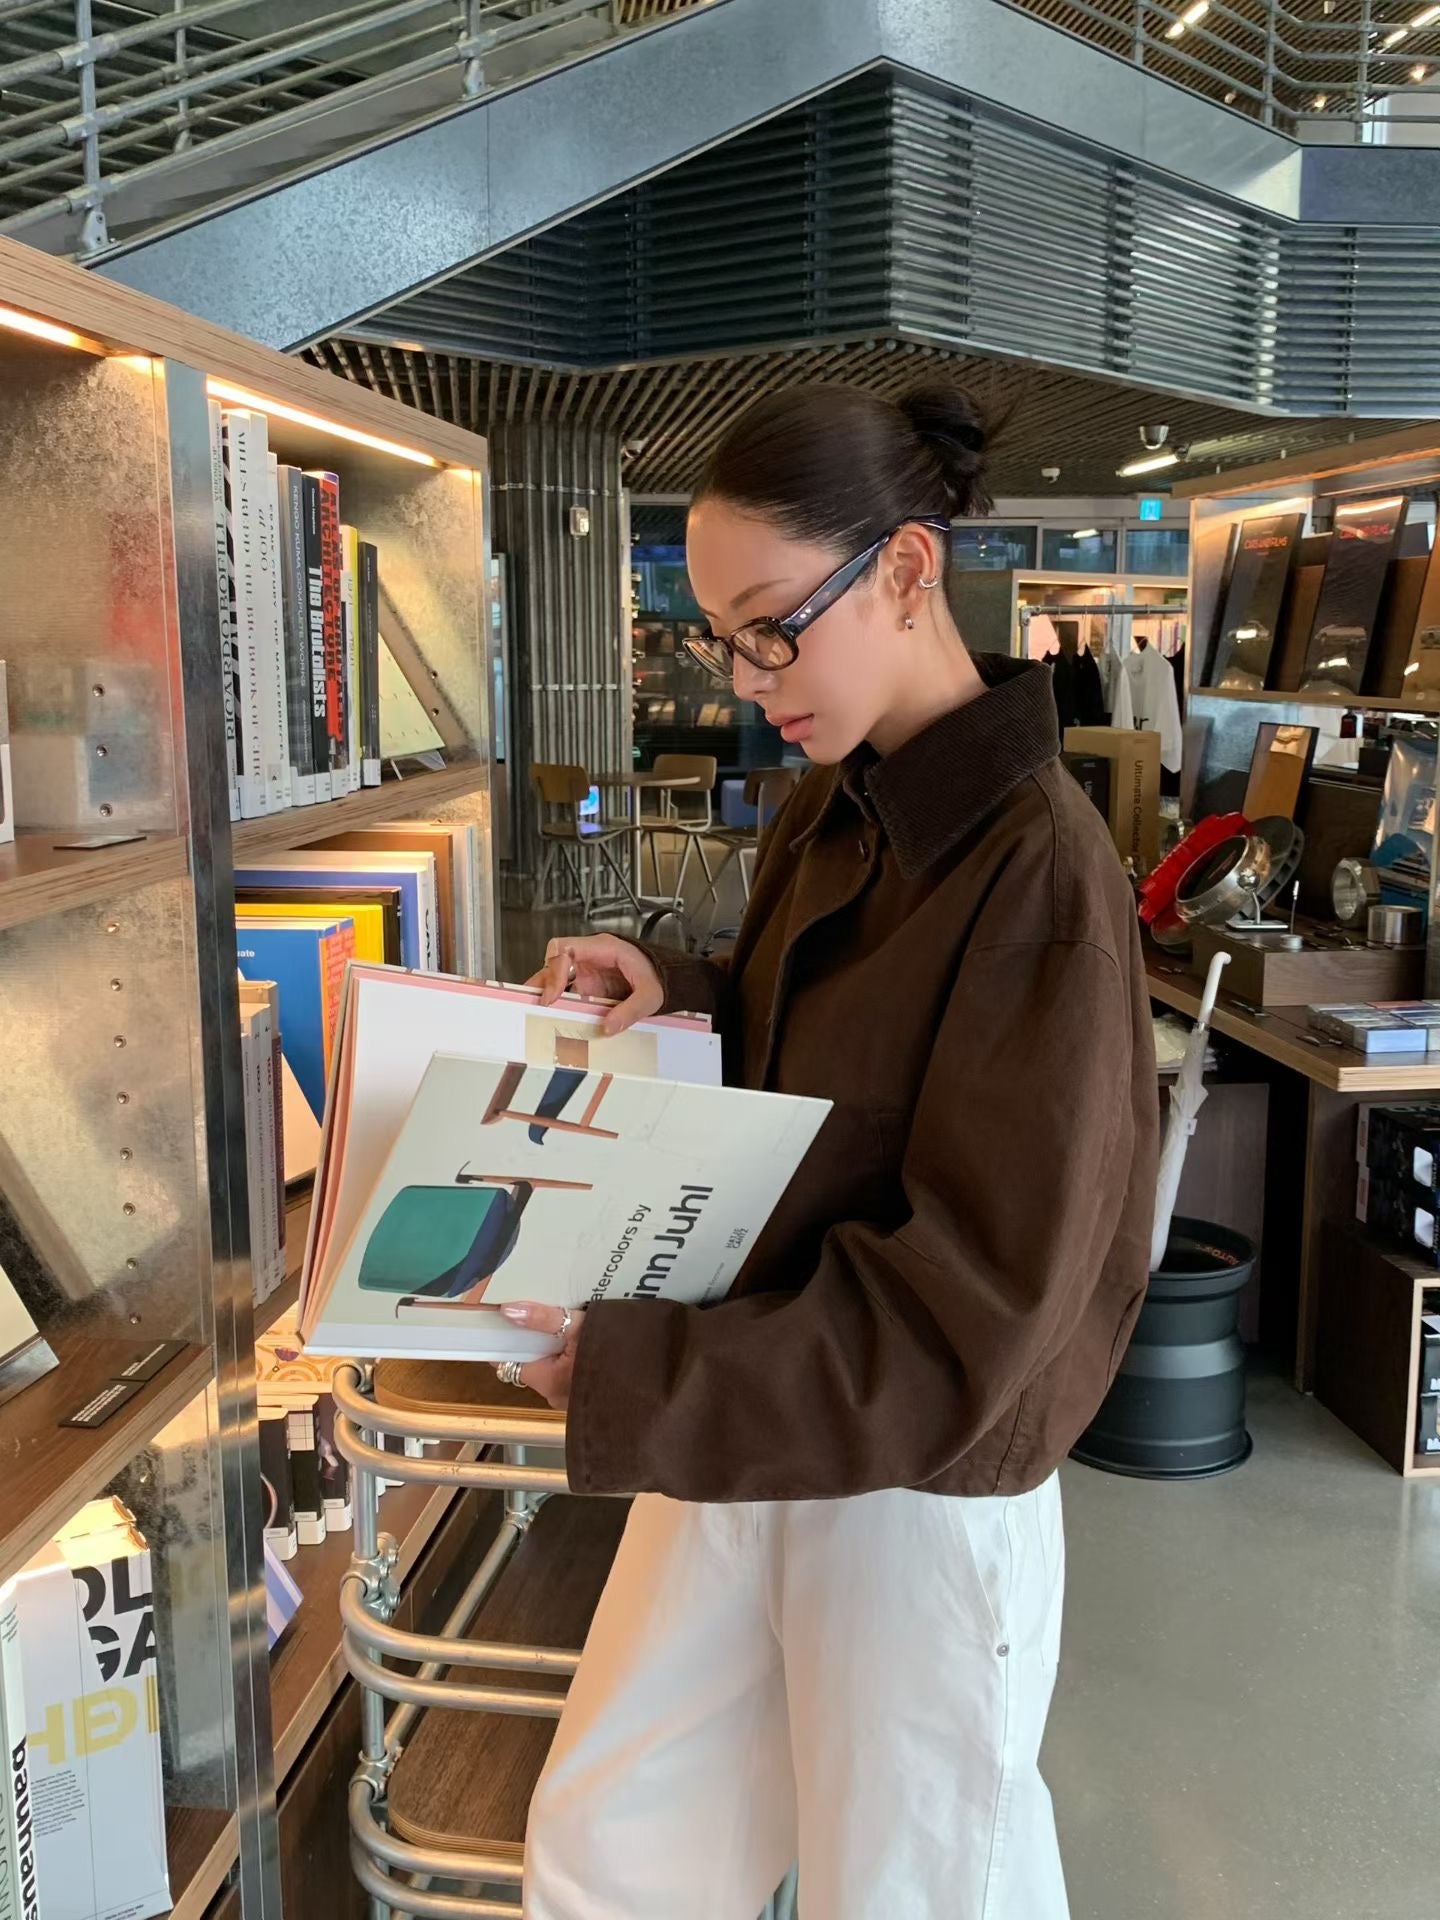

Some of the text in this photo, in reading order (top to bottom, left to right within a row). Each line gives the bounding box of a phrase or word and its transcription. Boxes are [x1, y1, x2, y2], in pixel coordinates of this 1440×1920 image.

[238, 431, 247, 492] MILES
[215, 512, 229, 611] BOFILL
[292, 485, 306, 687] KENGO KUMA COMPLETE WORKS
[320, 489, 336, 680] ARCHITECTURE
[220, 618, 236, 740] RICARDO
[308, 567, 327, 718] The Brutalists
[1131, 806, 1142, 852] Collector
[1133, 760, 1143, 803] Ultimate
[237, 949, 256, 958] ate
[590, 1203, 651, 1301] atercolors by
[624, 1184, 714, 1299] inn Juhl
[732, 1227, 749, 1249] CANTZ
[12, 1735, 40, 1920] bauhaus
